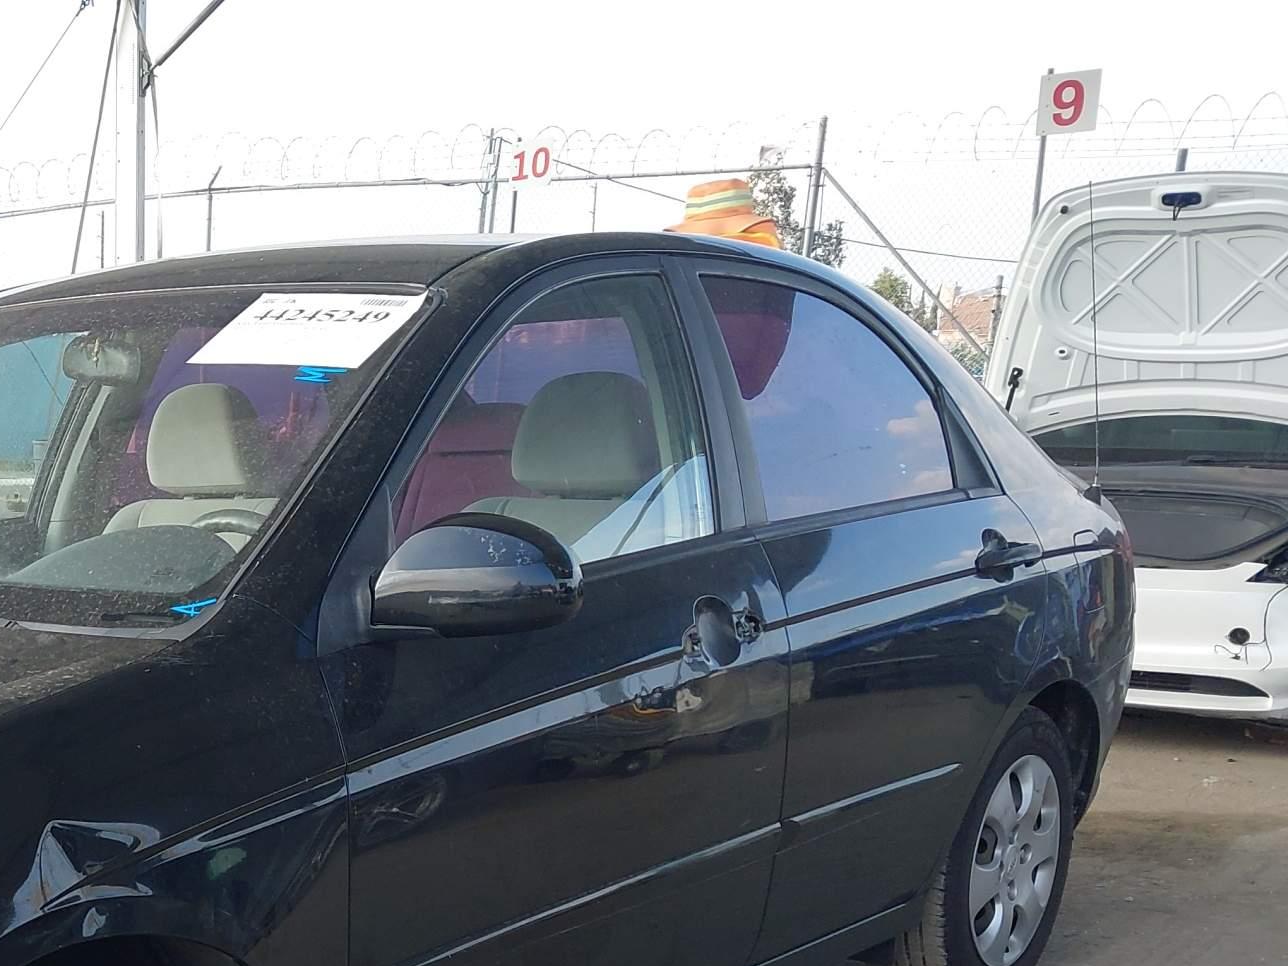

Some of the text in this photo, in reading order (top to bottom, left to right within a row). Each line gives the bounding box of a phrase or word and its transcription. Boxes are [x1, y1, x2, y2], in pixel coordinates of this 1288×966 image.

[1052, 79, 1085, 127] 9
[512, 147, 550, 181] 10
[253, 308, 391, 323] 44245249
